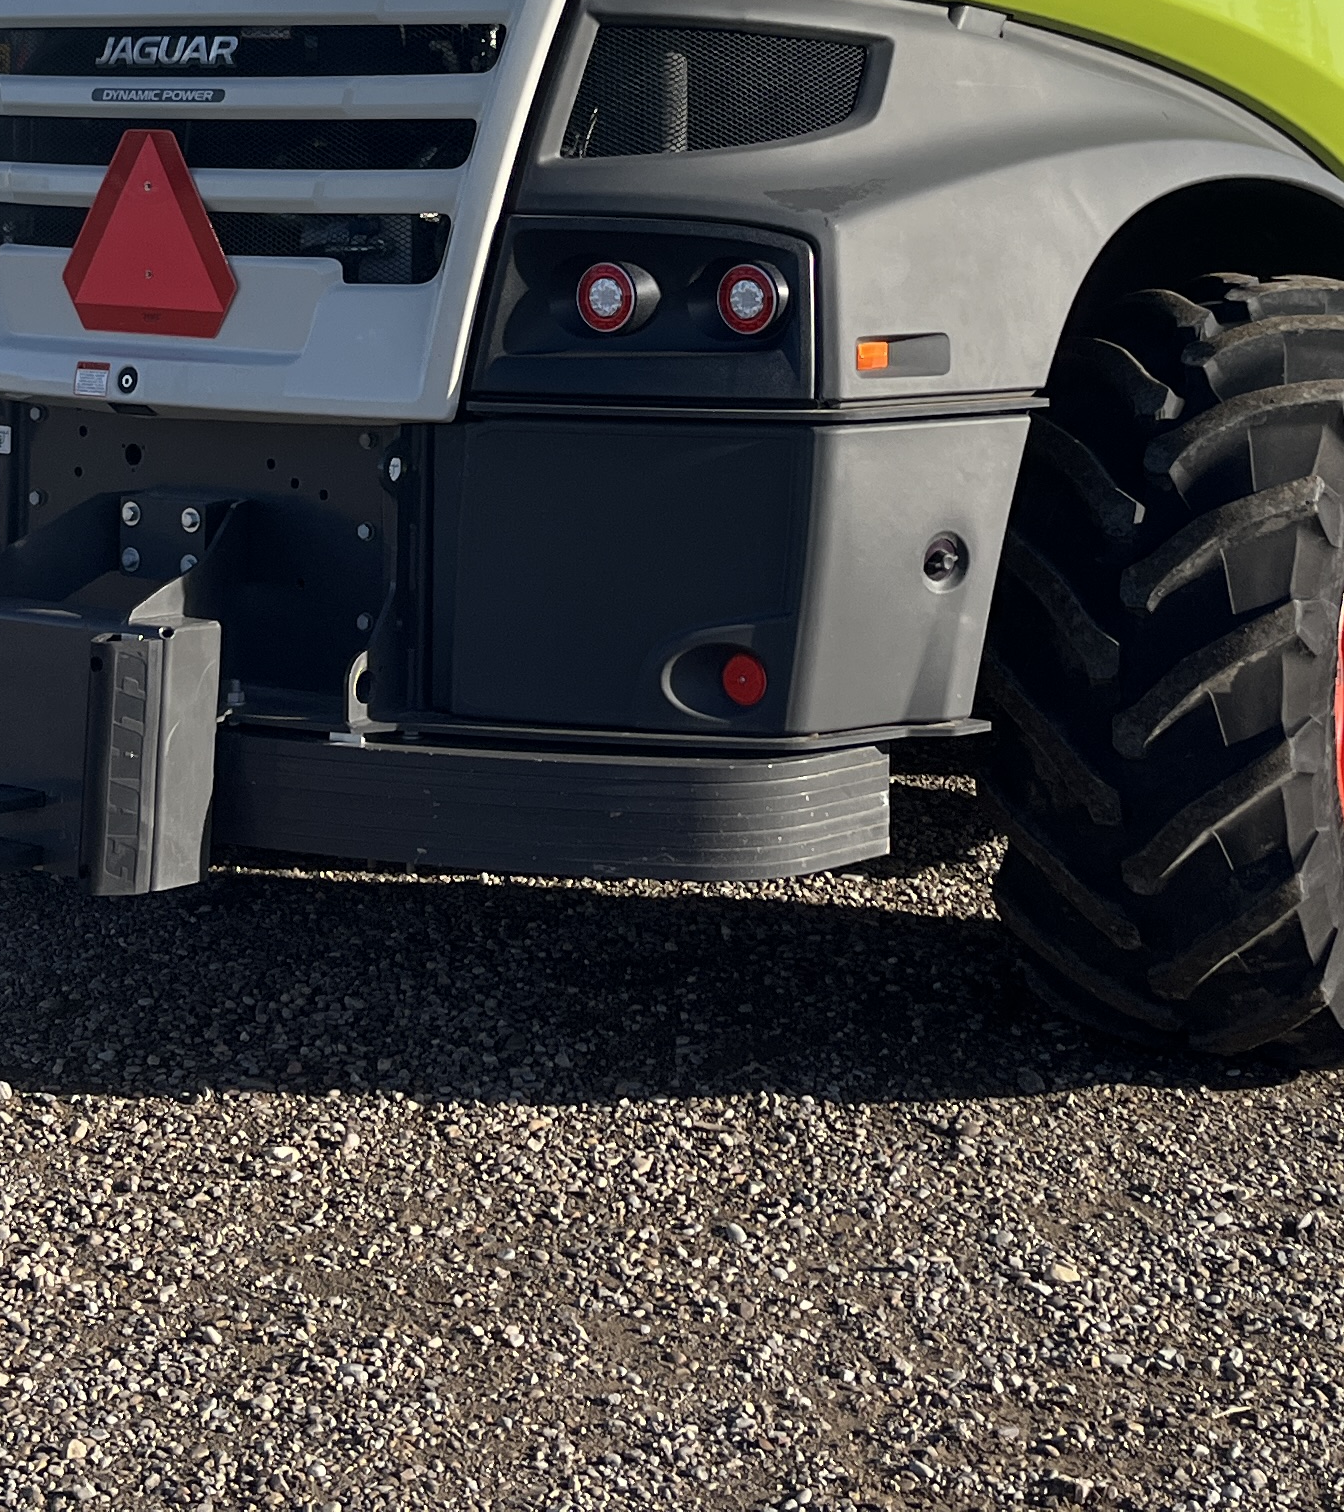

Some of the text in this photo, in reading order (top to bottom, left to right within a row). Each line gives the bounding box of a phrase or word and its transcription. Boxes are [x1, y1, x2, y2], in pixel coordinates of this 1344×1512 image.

[95, 36, 239, 66] JAGUAR
[102, 90, 214, 101] DYNAMIC POWER
